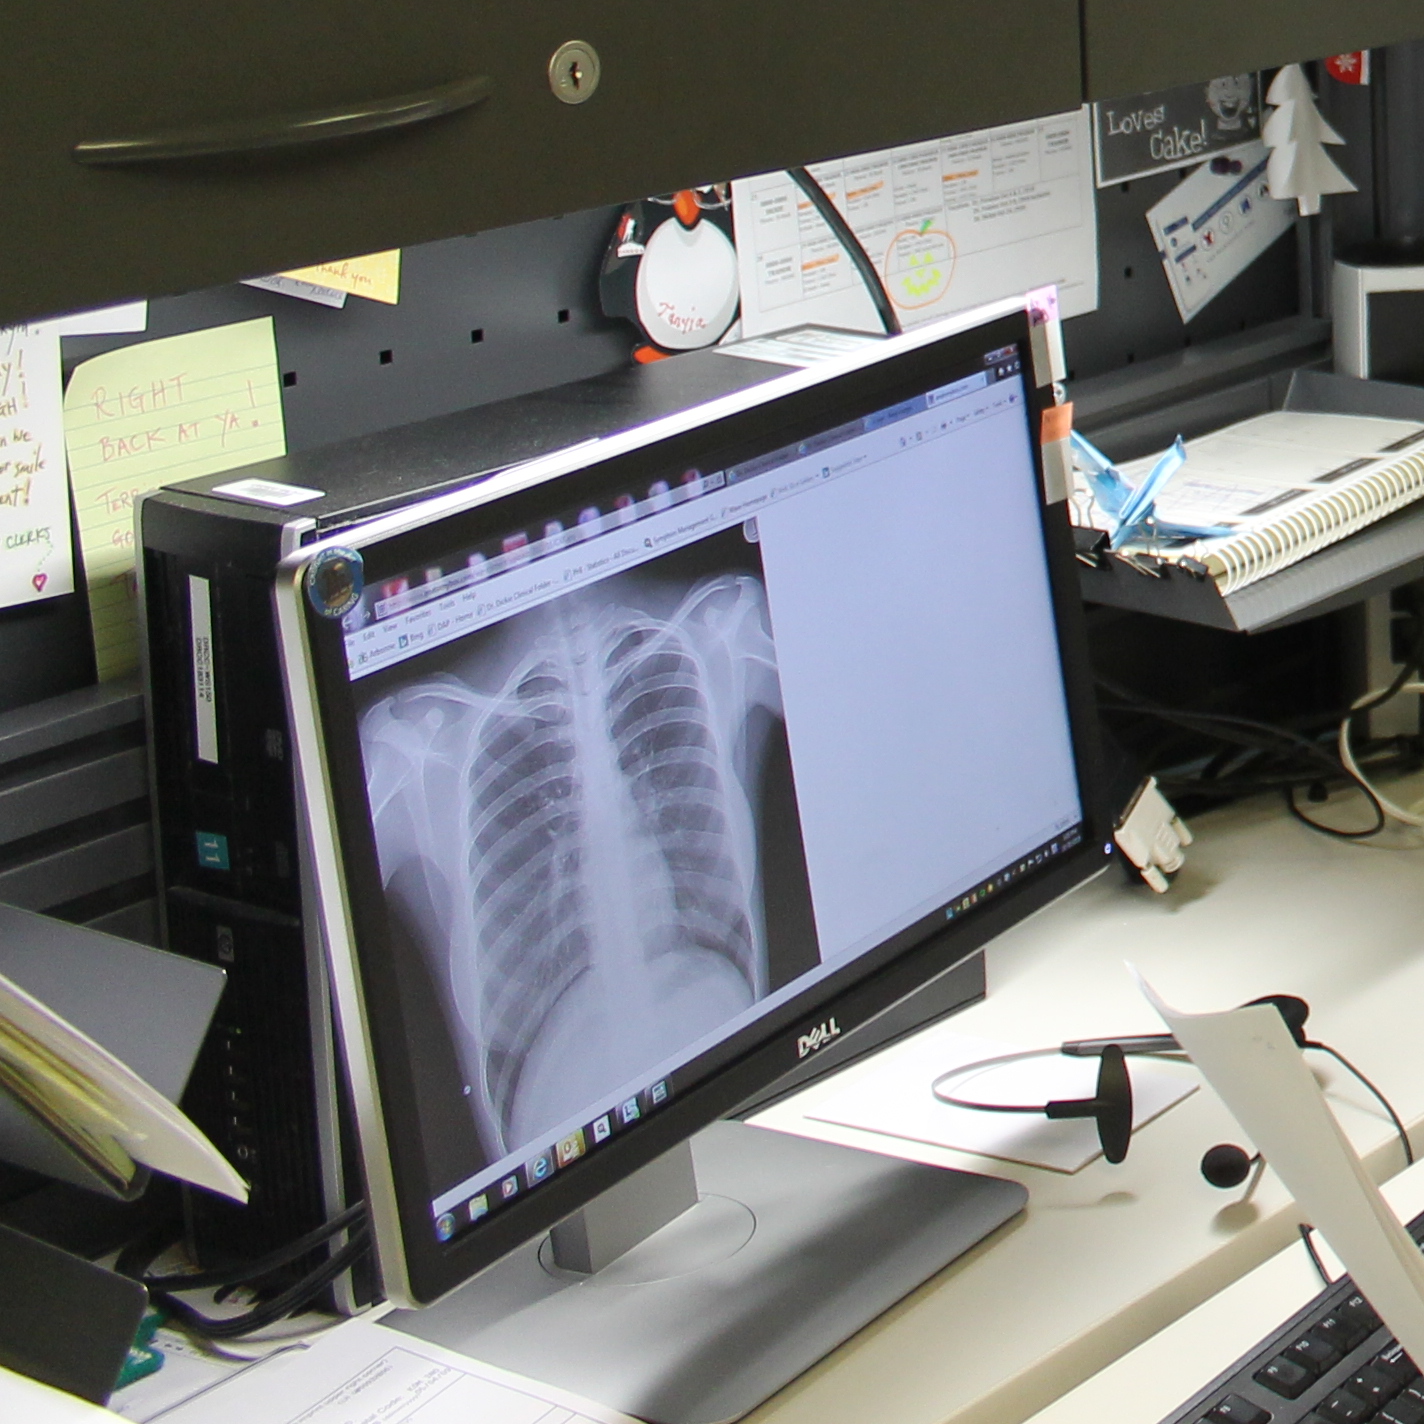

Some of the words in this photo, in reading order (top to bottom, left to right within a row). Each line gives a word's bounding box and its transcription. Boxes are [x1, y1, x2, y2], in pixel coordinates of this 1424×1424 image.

[1106, 104, 1165, 136] Loves
[1150, 119, 1208, 161] Cake!
[91, 373, 188, 420] RIGHT
[99, 428, 165, 462] BACK
[178, 422, 201, 442] AT
[797, 1017, 841, 1059] DELL
